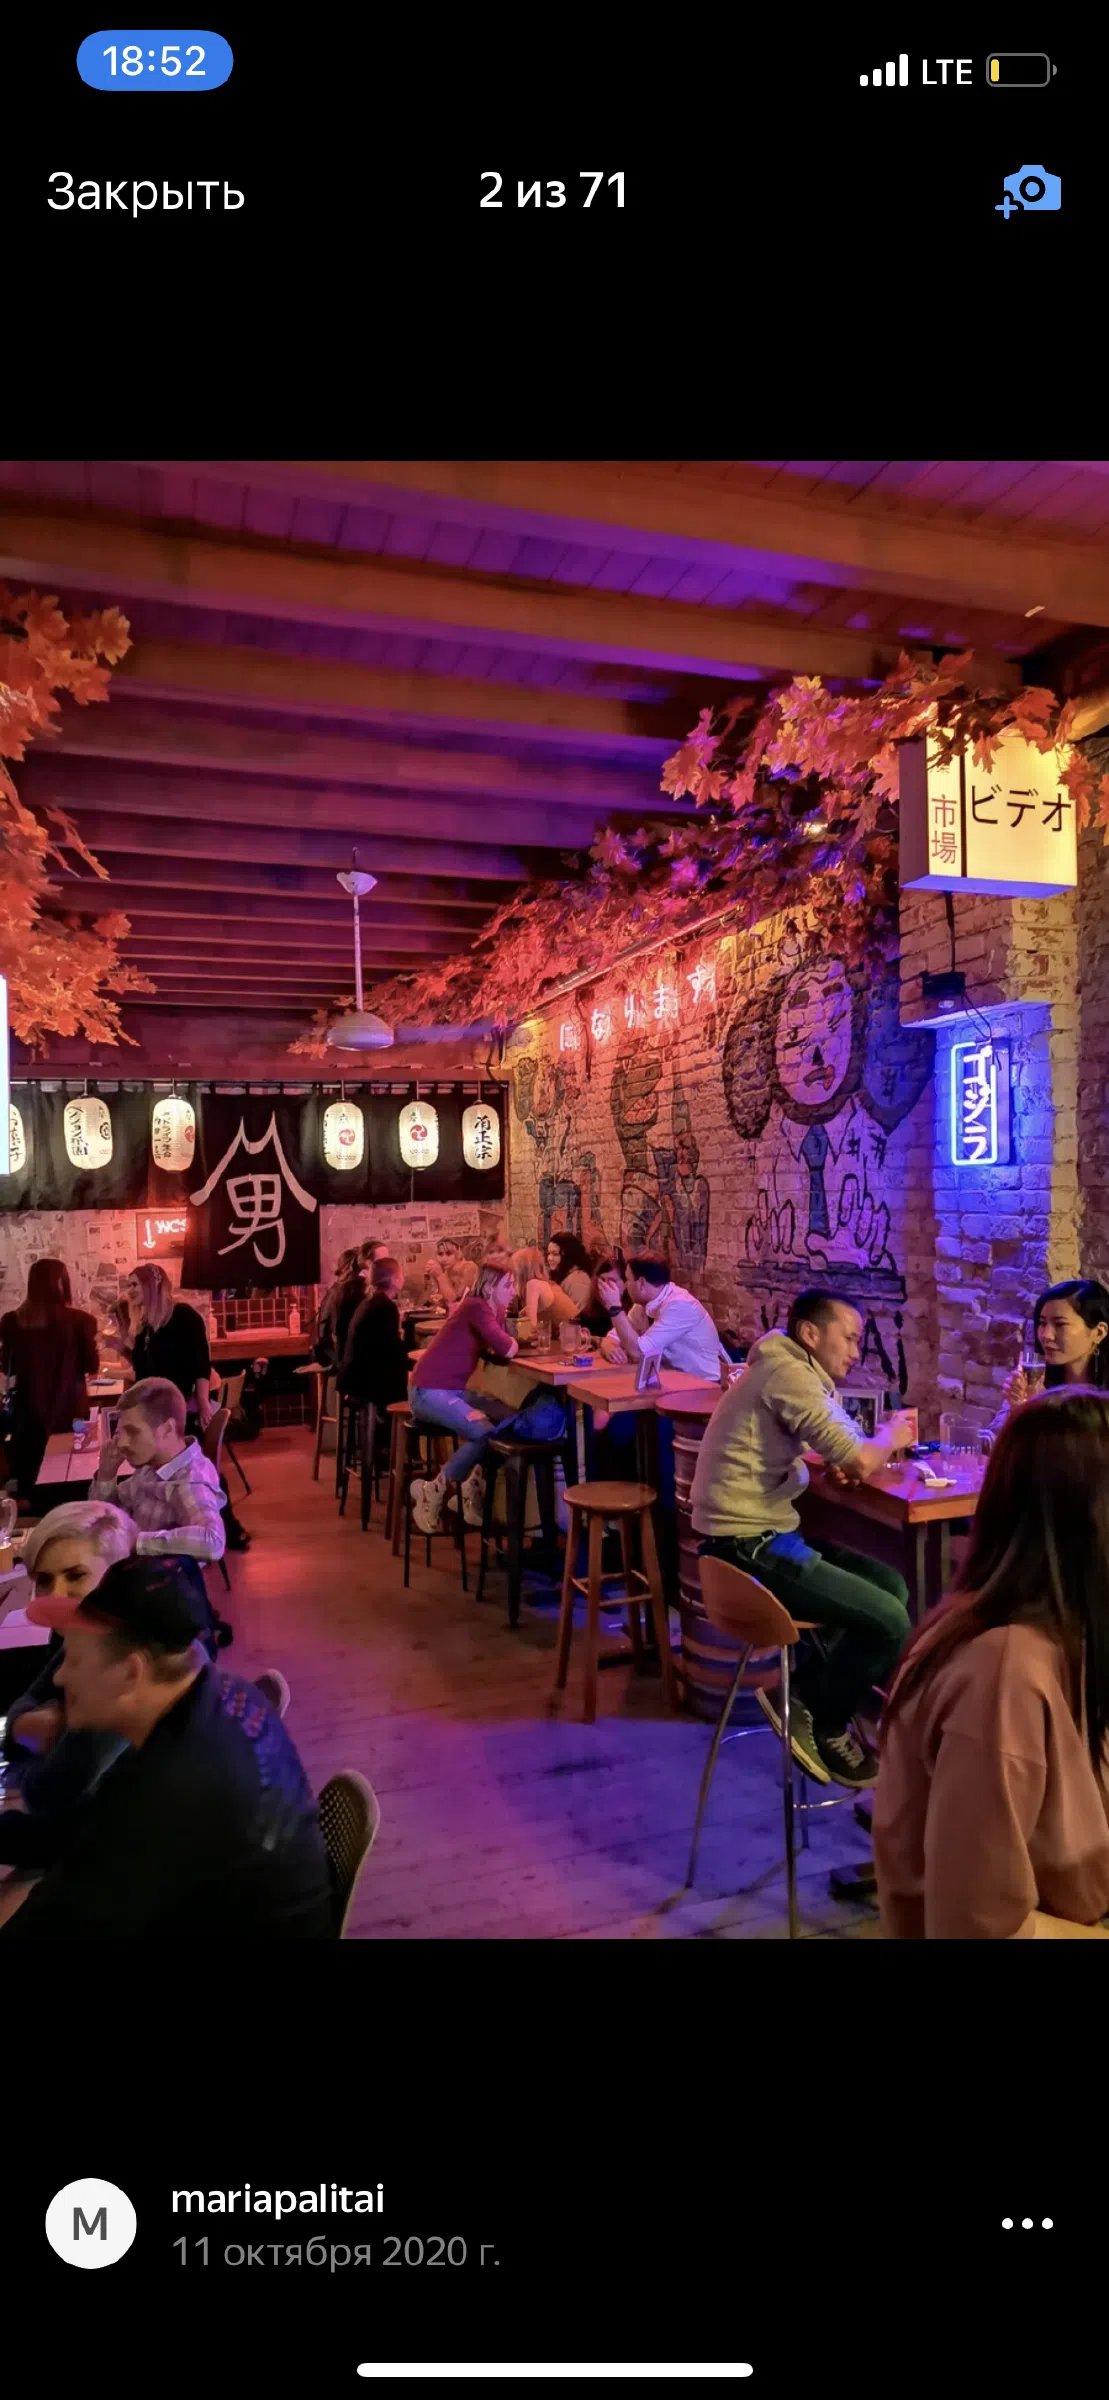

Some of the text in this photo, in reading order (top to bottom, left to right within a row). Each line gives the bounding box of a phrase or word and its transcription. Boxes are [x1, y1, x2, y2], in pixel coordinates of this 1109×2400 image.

[931, 794, 958, 864] 市場
[971, 784, 1072, 832] ビデオ
[962, 1044, 992, 1161] ゴジラ
